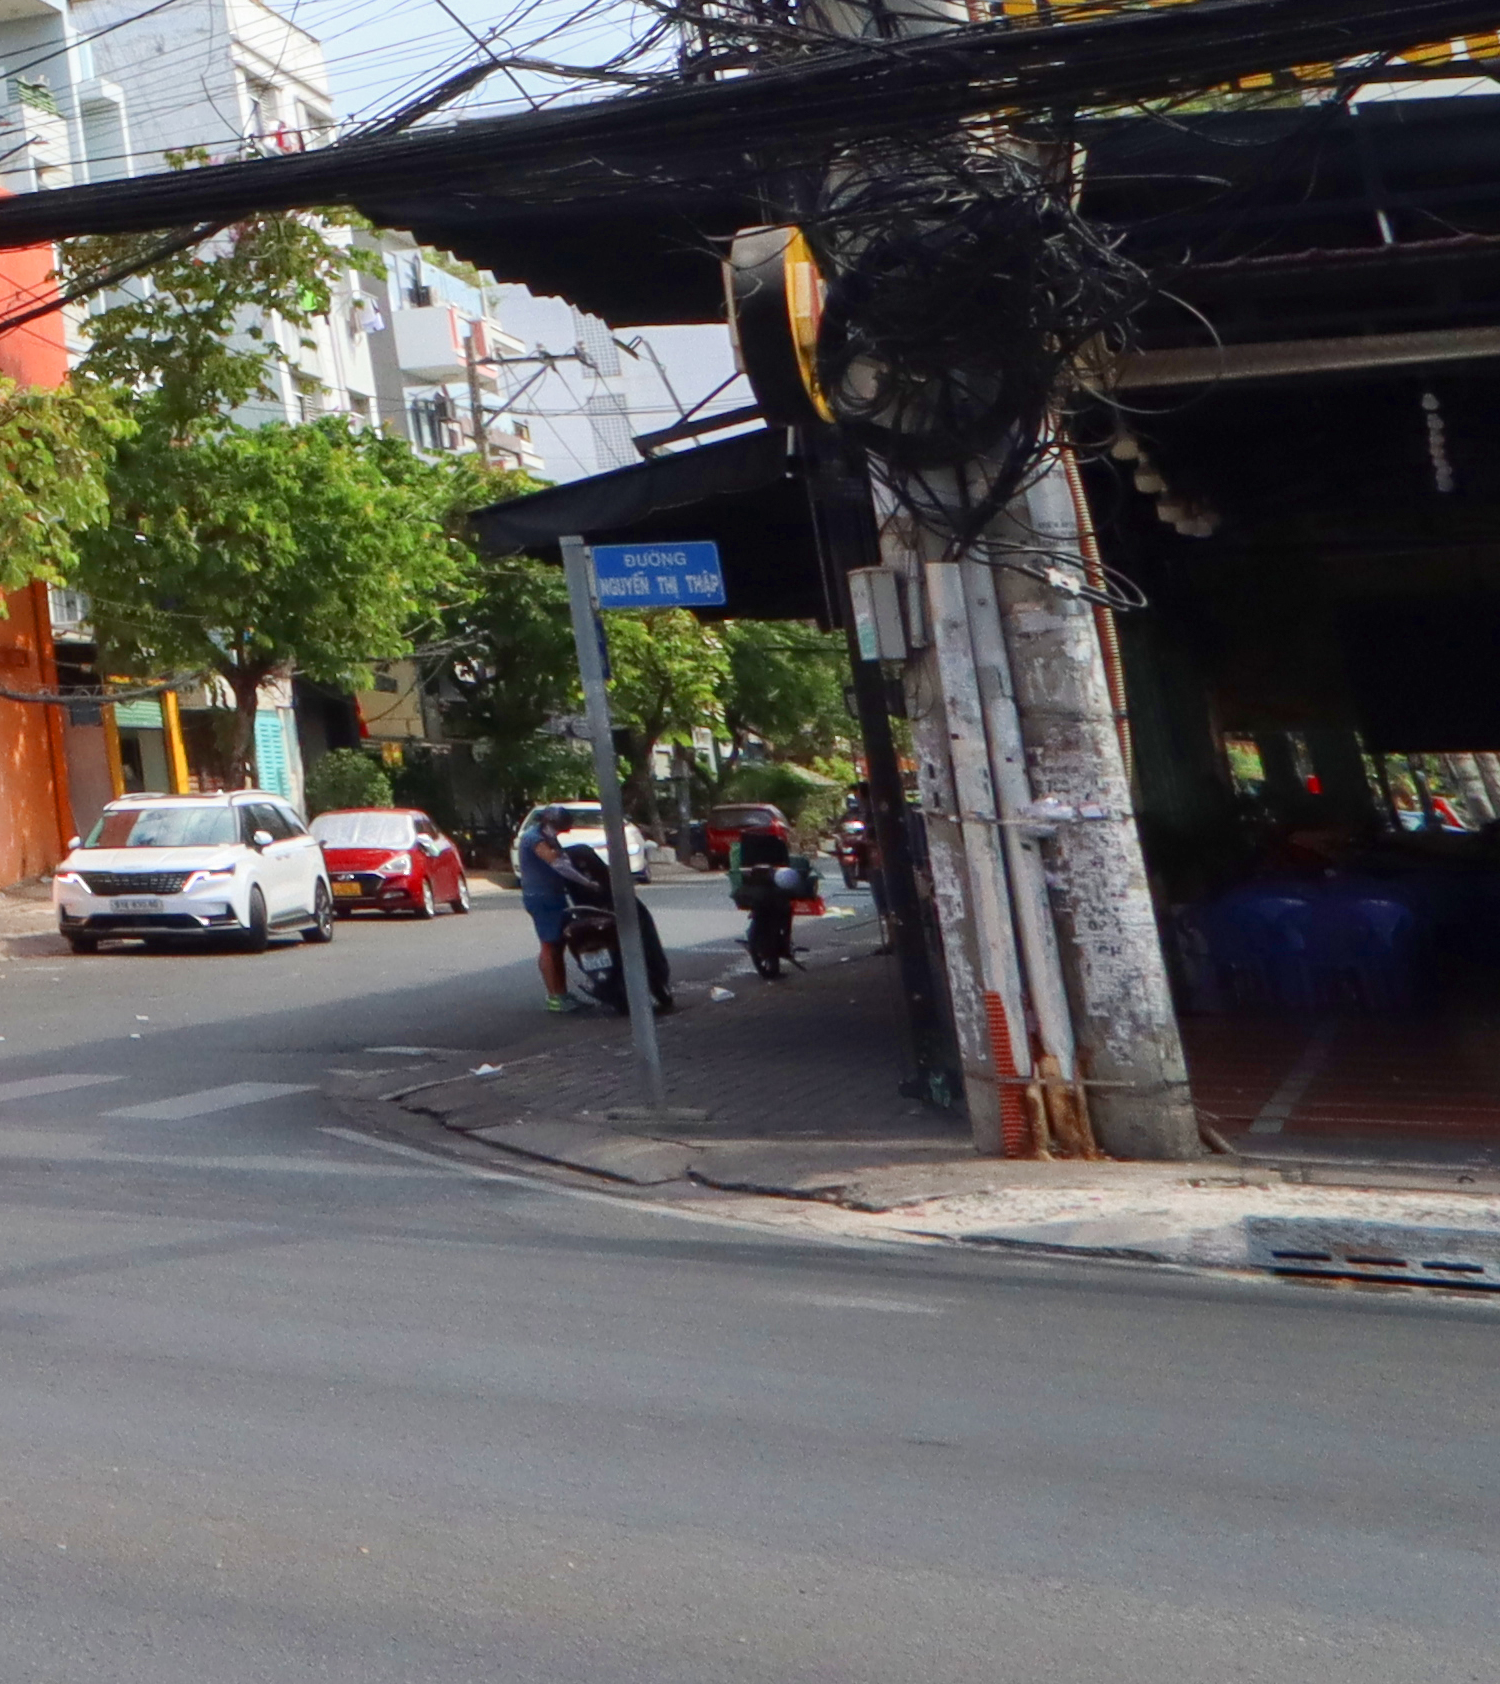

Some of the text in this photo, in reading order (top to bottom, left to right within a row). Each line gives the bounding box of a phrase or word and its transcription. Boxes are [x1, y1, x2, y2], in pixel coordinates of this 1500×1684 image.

[623, 549, 687, 568] ĐƯỜNG
[599, 570, 720, 600] NGUYỄN THỊ THẬP
